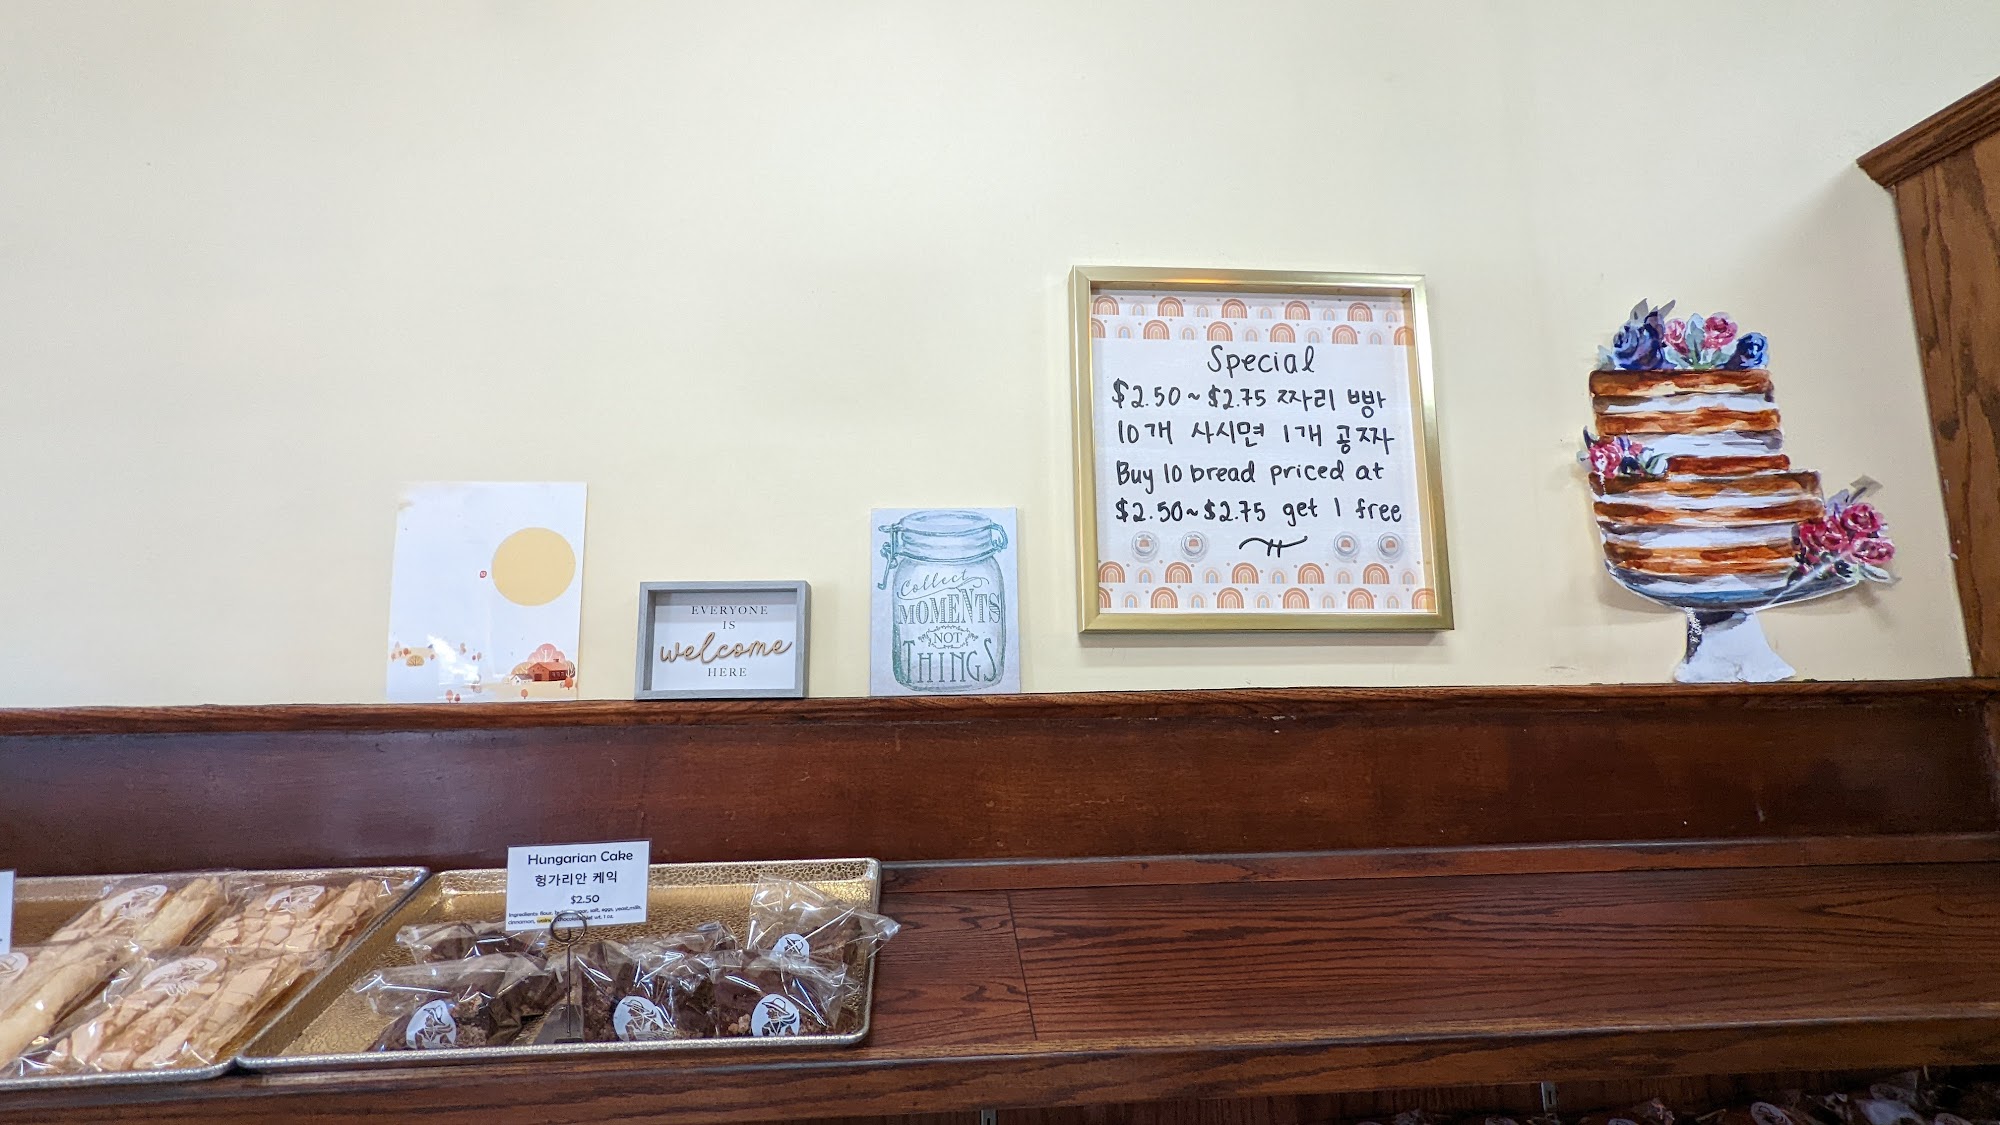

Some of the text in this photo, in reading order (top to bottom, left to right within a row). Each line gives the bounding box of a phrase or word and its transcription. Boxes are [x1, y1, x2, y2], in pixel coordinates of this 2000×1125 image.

[1206, 344, 1316, 379] Special
[1276, 387, 1336, 412] 짜리
[1347, 388, 1387, 419] 빵
[1117, 420, 1395, 456] 10개 사시면 1개 공짜
[1116, 459, 1385, 495] Buy 10 bread priced at
[1282, 497, 1319, 527] get
[1355, 498, 1402, 523] free
[898, 568, 973, 598] Collect
[691, 605, 769, 615] EVERYONE
[898, 588, 1001, 625] MOMENTS
[722, 620, 736, 630] IS
[933, 632, 963, 644] NOT
[659, 631, 793, 664] welcome
[902, 637, 998, 683] THINGS
[707, 667, 748, 677] HERE
[527, 850, 633, 867] Hungarian Cake
[535, 870, 618, 888] 헝가리안 케익
[570, 894, 600, 905] $2.50
